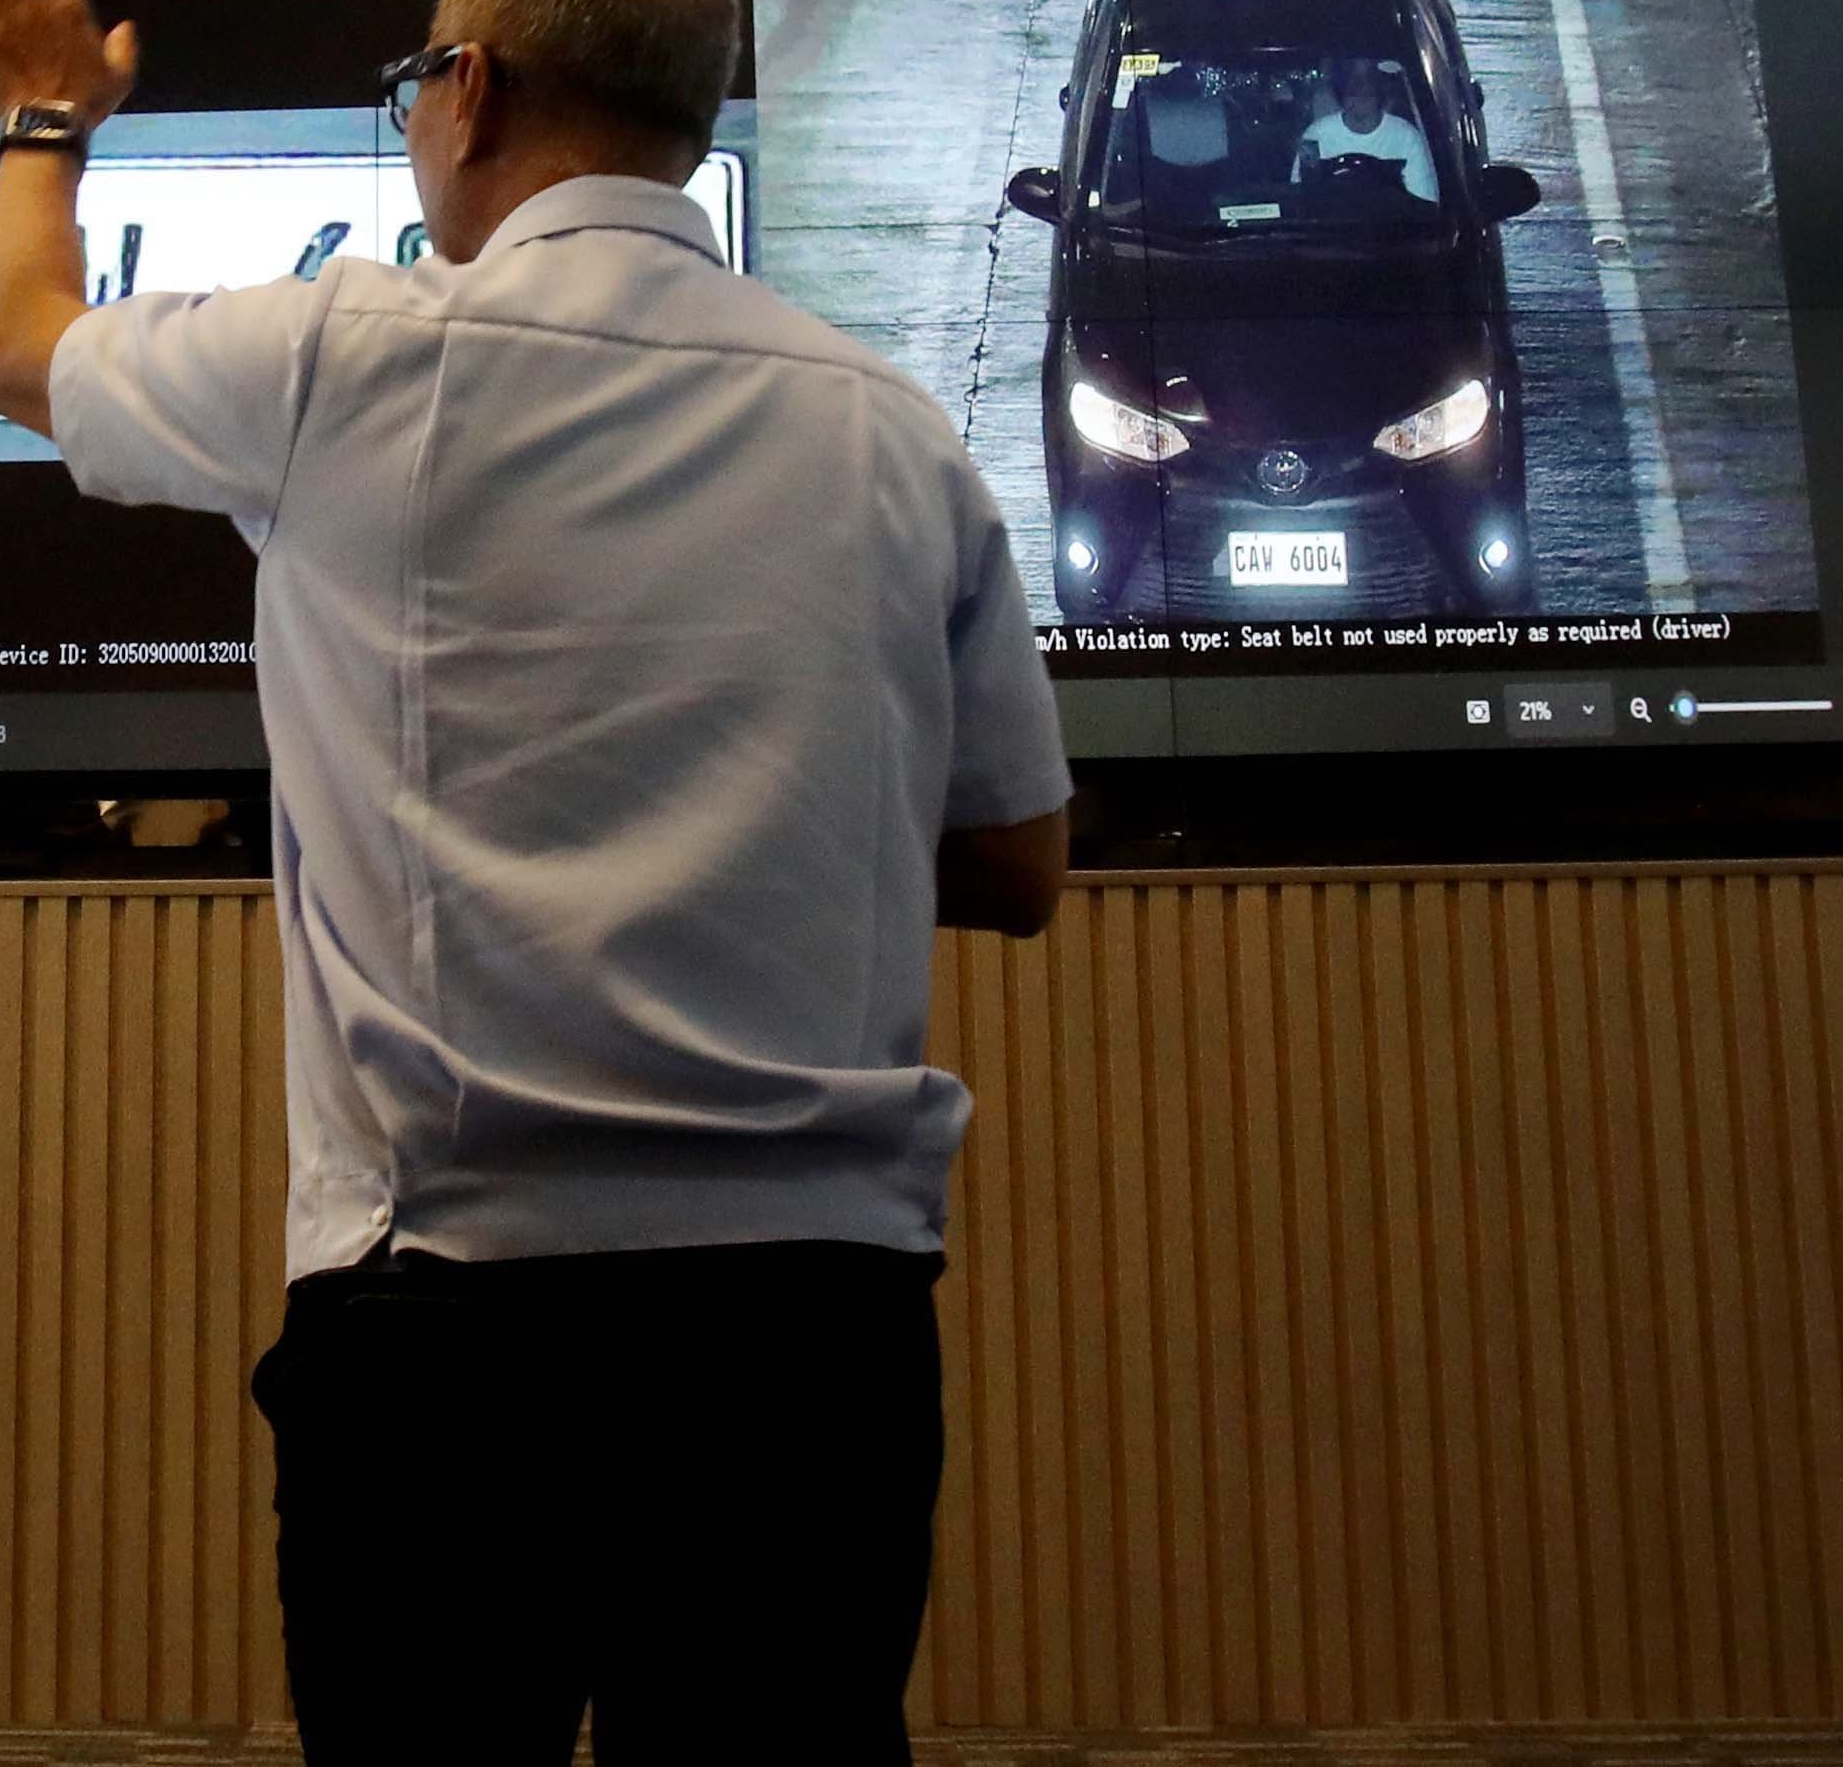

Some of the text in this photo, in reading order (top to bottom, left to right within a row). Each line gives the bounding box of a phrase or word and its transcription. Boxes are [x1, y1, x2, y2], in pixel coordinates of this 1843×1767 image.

[1290, 545, 1342, 571] 6004
[1076, 614, 1732, 652] Violation type: Seat belt not used properly as required (driver)
[60, 645, 87, 666] ID:
[1519, 701, 1552, 722] 21%
